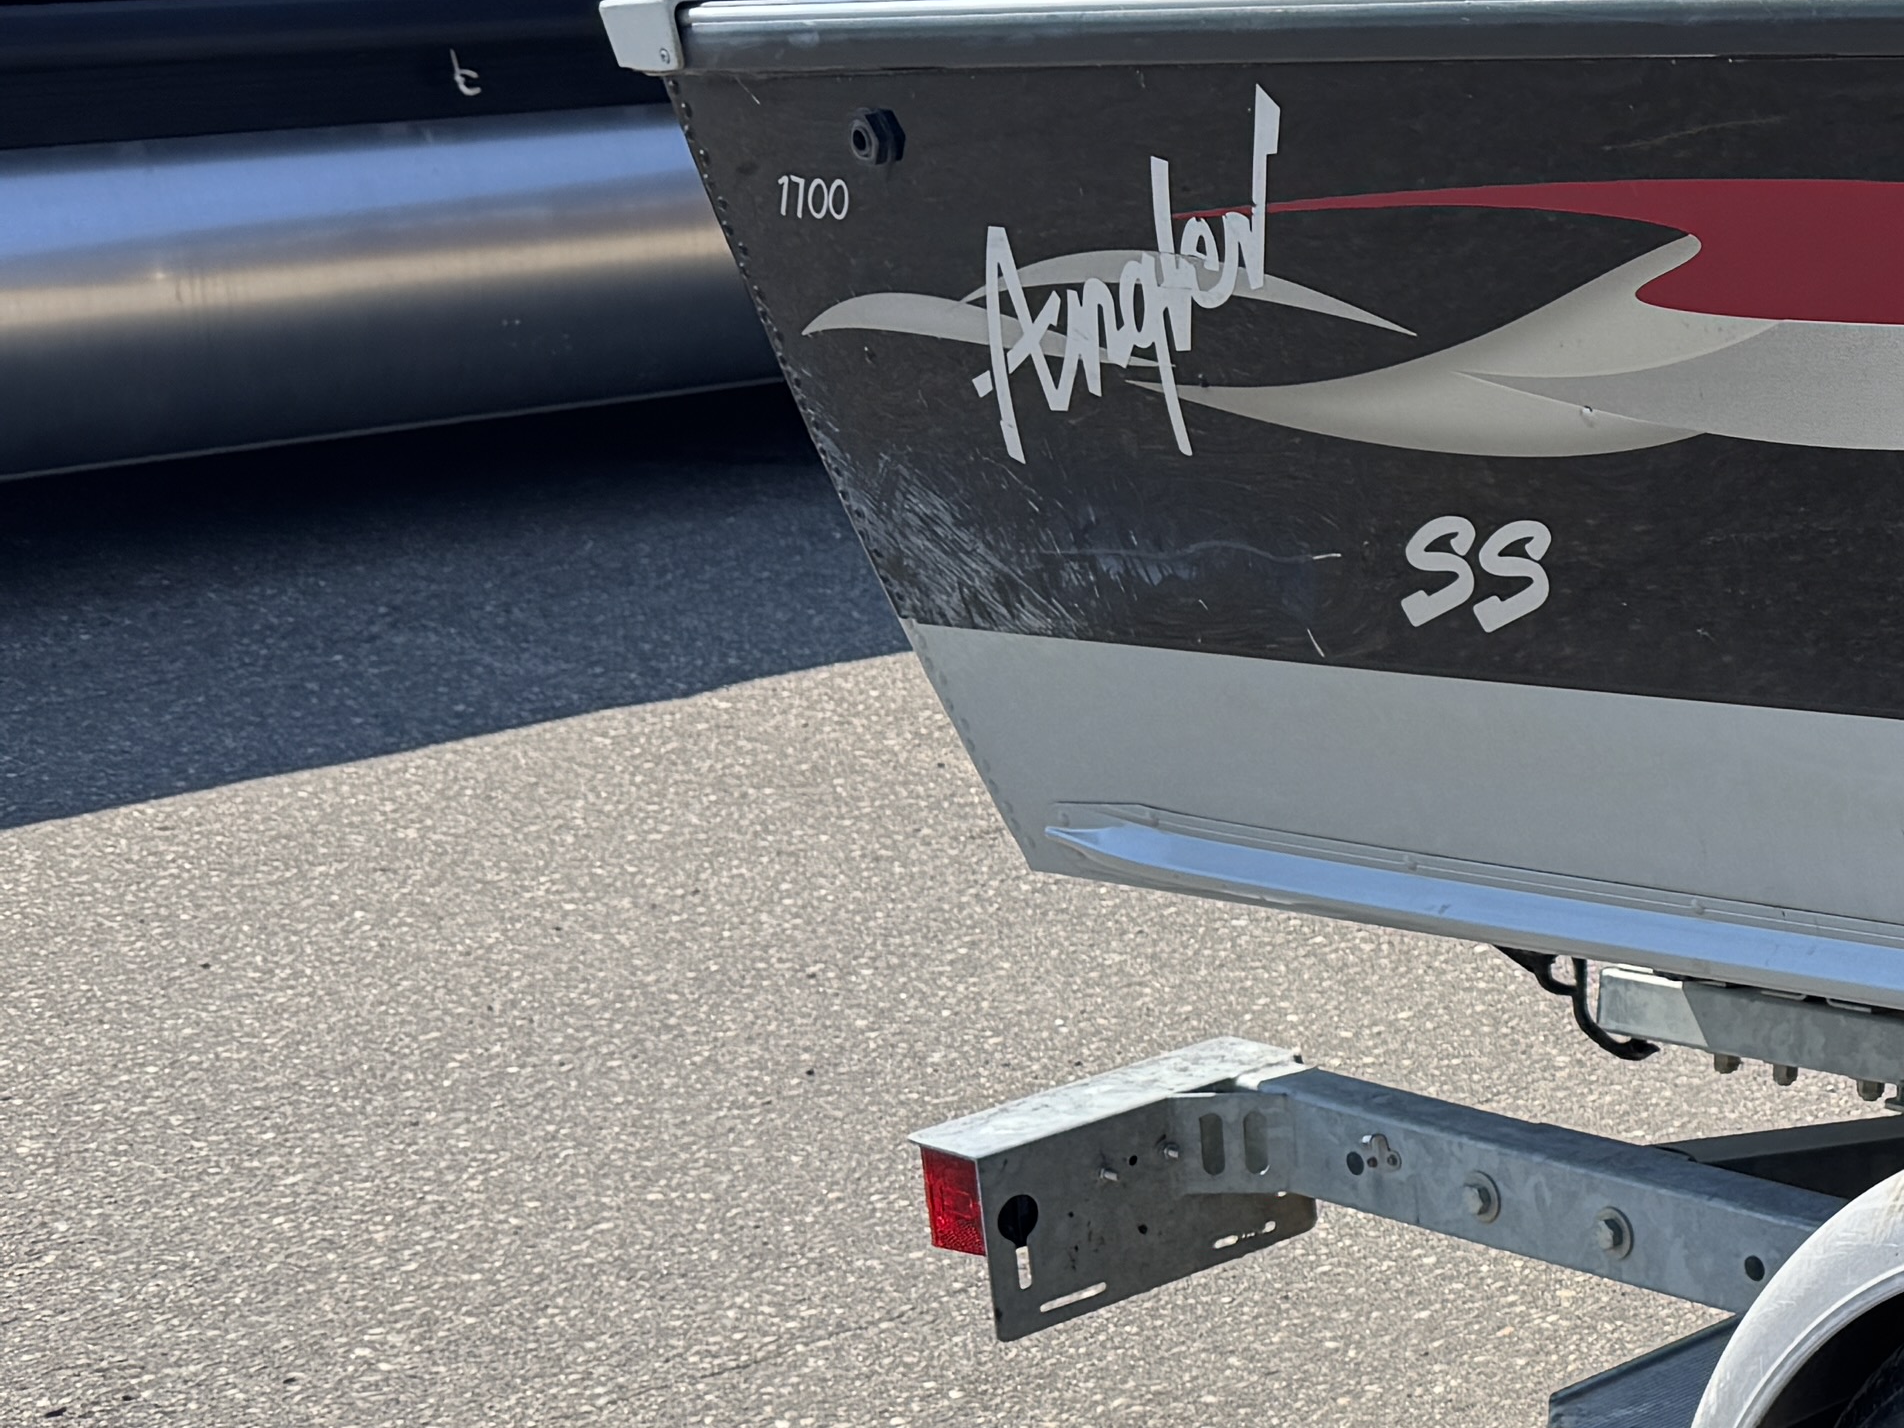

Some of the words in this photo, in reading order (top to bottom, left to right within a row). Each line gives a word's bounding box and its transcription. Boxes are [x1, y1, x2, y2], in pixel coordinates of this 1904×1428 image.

[777, 174, 850, 221] 1700
[972, 83, 1281, 464] Angler
[1400, 514, 1552, 634] SS
